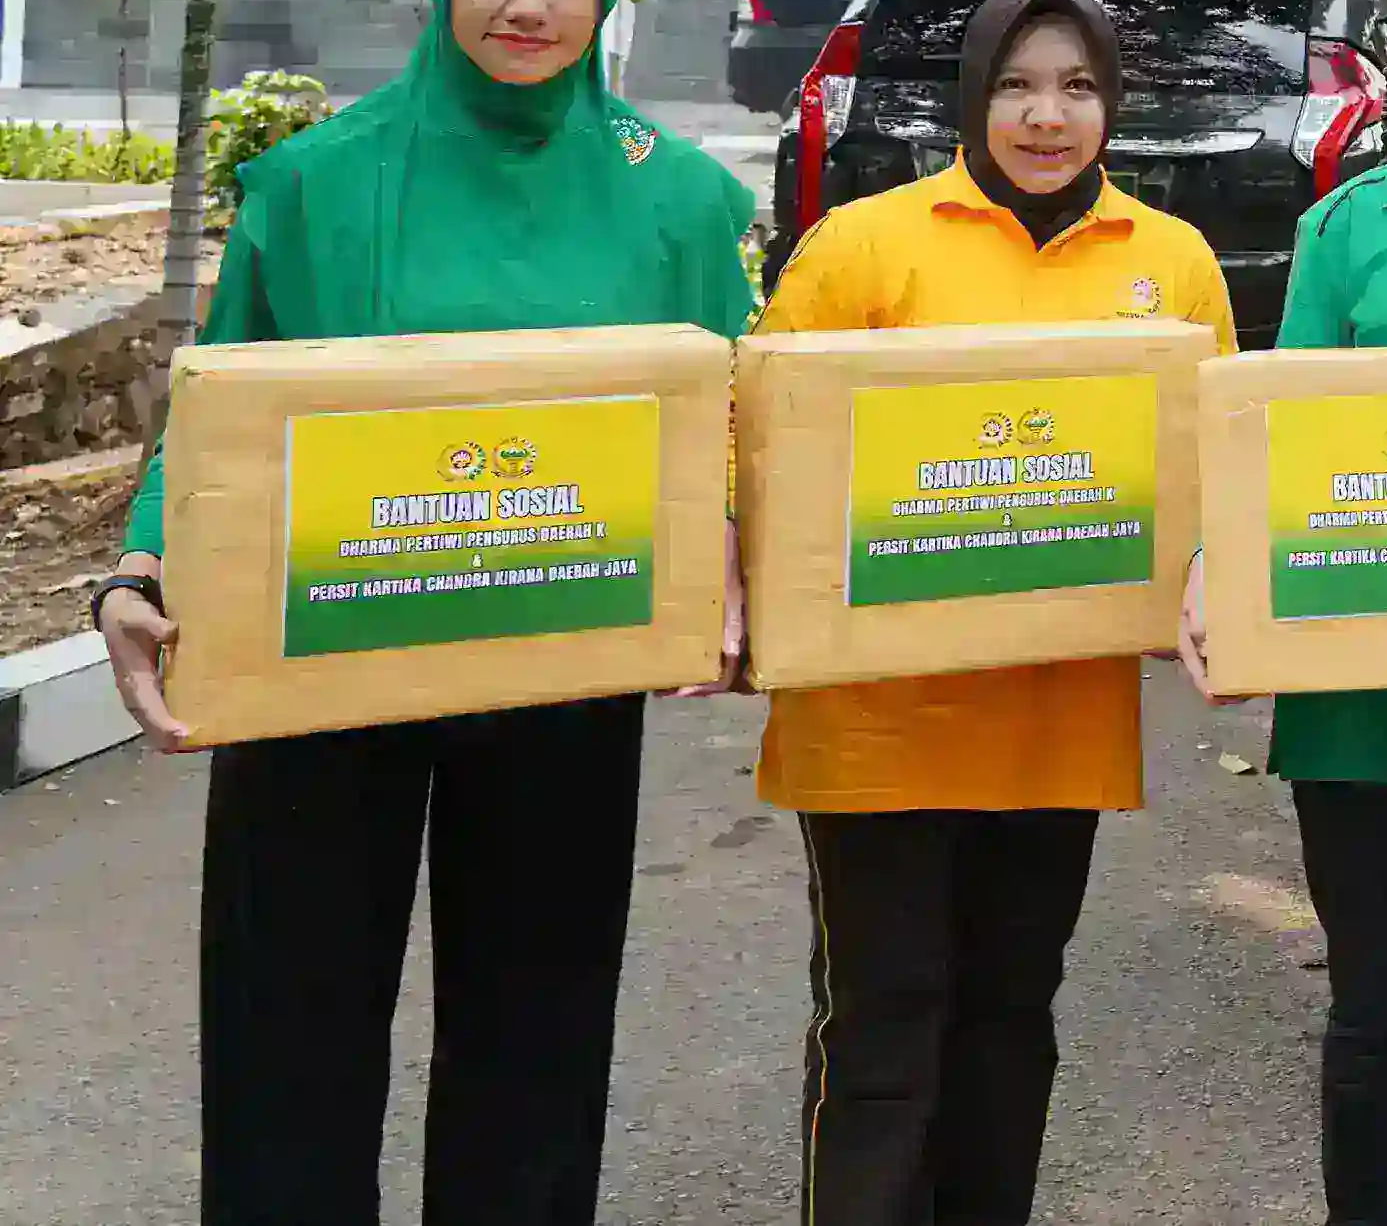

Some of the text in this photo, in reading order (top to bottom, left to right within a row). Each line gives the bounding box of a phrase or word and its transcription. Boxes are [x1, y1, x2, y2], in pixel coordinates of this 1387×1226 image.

[918, 452, 1095, 490] BANTUAN SOSIAL
[372, 484, 584, 528] BANTUAN SOSIAL
[1002, 513, 1012, 526] &
[339, 537, 401, 558] DHARMA
[406, 532, 462, 553] PERTIWI
[467, 527, 537, 549] PENGURUS
[540, 524, 593, 542] DAERAH
[913, 534, 962, 553] KARTIKA
[471, 554, 483, 568] &
[1288, 551, 1326, 568] PERSIT
[1330, 548, 1378, 566] KARTIKA
[309, 558, 638, 602] PERSIT KARTIKA CHANDRA KIRANA DAERAH JAYA
